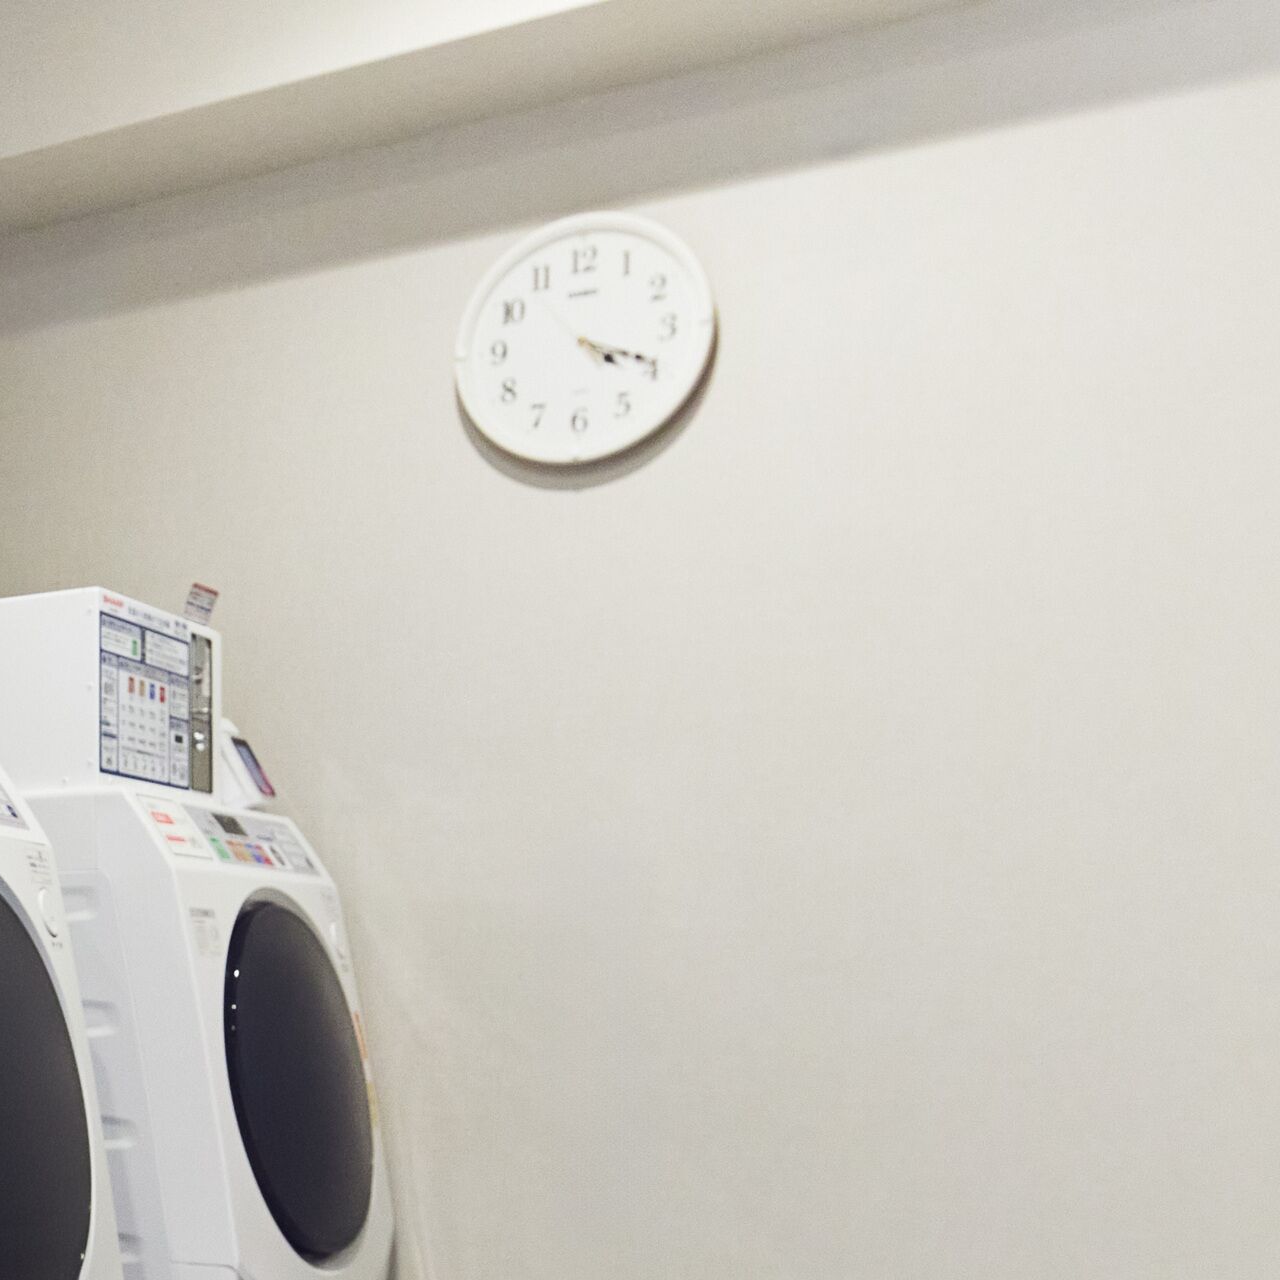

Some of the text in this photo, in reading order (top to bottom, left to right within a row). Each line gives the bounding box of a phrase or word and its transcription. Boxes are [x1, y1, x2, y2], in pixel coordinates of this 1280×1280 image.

[572, 246, 597, 274] 12
[624, 251, 630, 276] 1
[533, 266, 550, 291] 11
[650, 274, 667, 301] 2
[503, 299, 525, 325] 10
[659, 313, 677, 340] 3
[491, 340, 507, 366] 9
[501, 377, 517, 403] 8
[531, 403, 546, 428] 7
[614, 392, 630, 418] 5
[571, 407, 588, 433] 6
